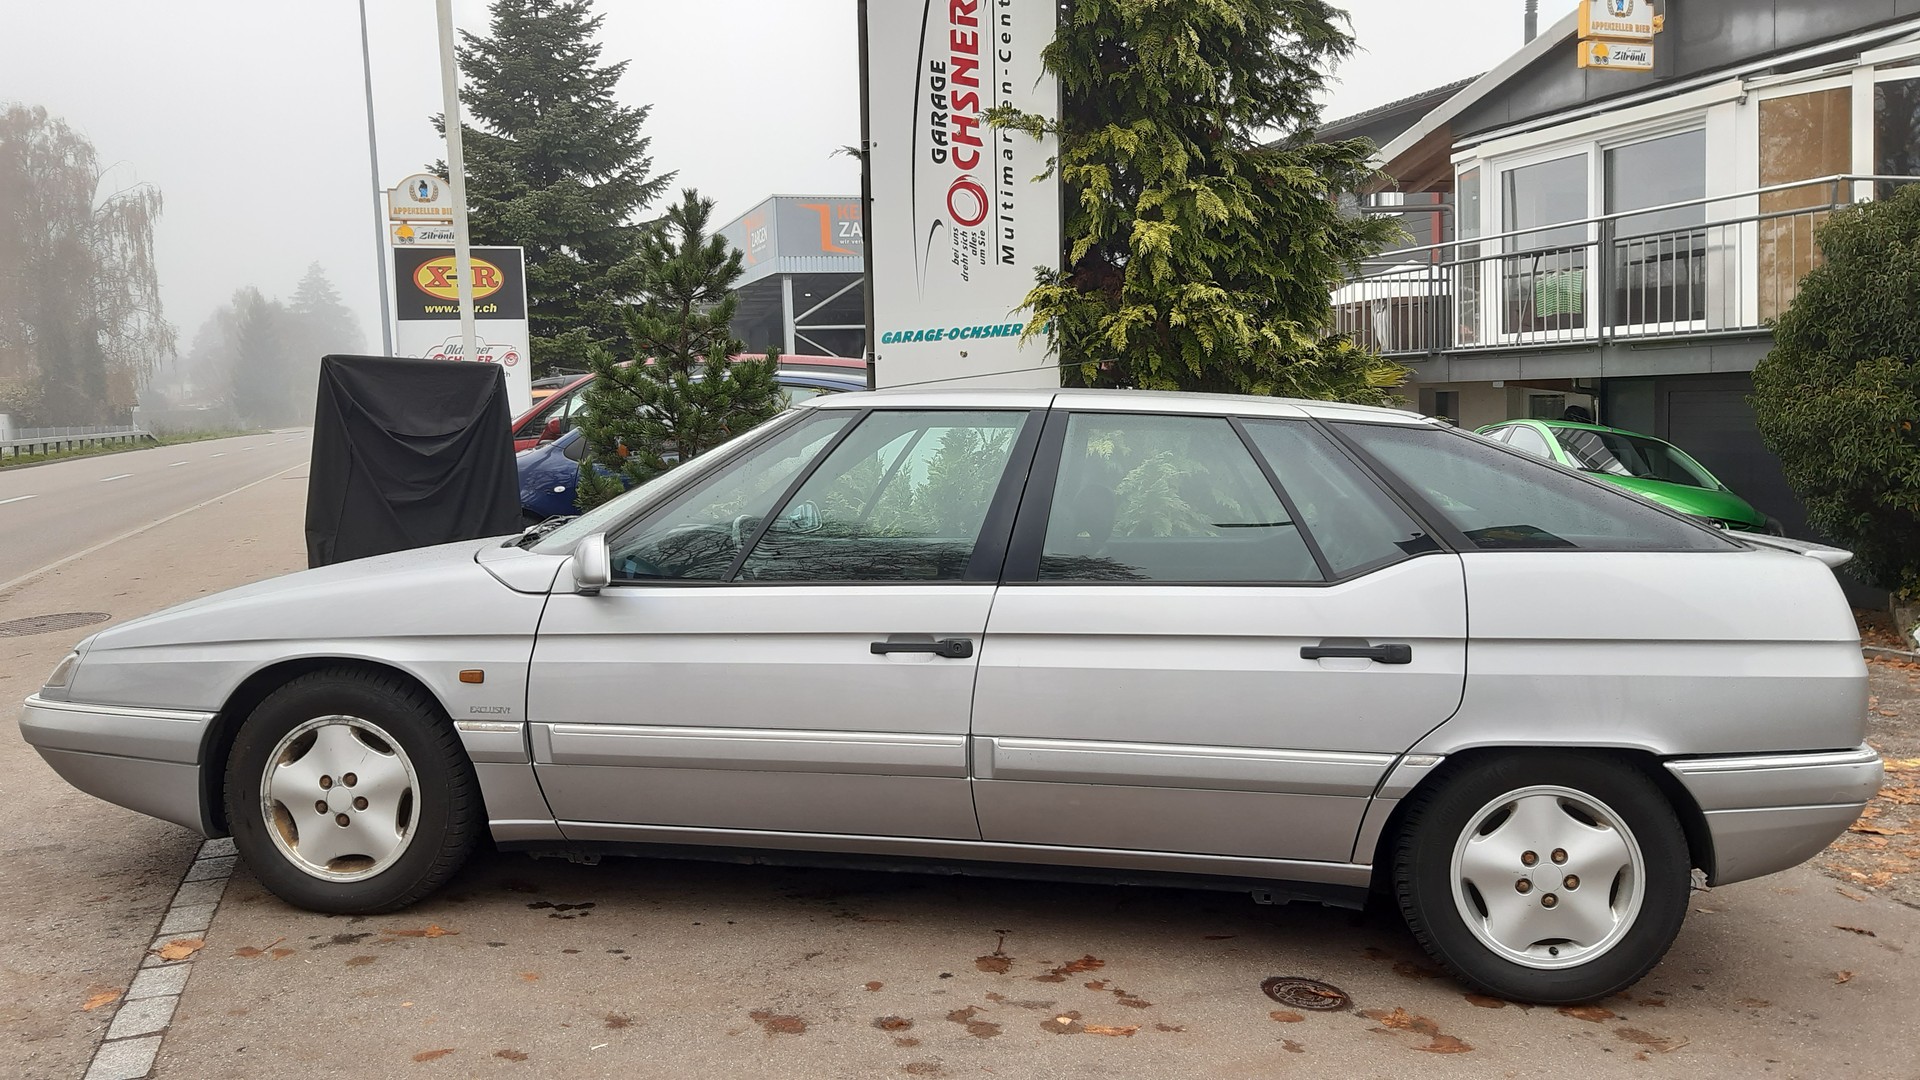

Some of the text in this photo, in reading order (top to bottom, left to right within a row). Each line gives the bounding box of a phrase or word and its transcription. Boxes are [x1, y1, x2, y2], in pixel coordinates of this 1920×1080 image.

[1591, 21, 1651, 33] APPENZELLER BIER
[930, 60, 948, 164] GARAGE
[998, 0, 1014, 265] Multimaren-Cent
[393, 206, 439, 215] APPENZELLER
[952, 247, 960, 265] bei
[960, 230, 969, 282] dreht sich
[969, 231, 978, 256] alles
[978, 230, 986, 265] um Sie
